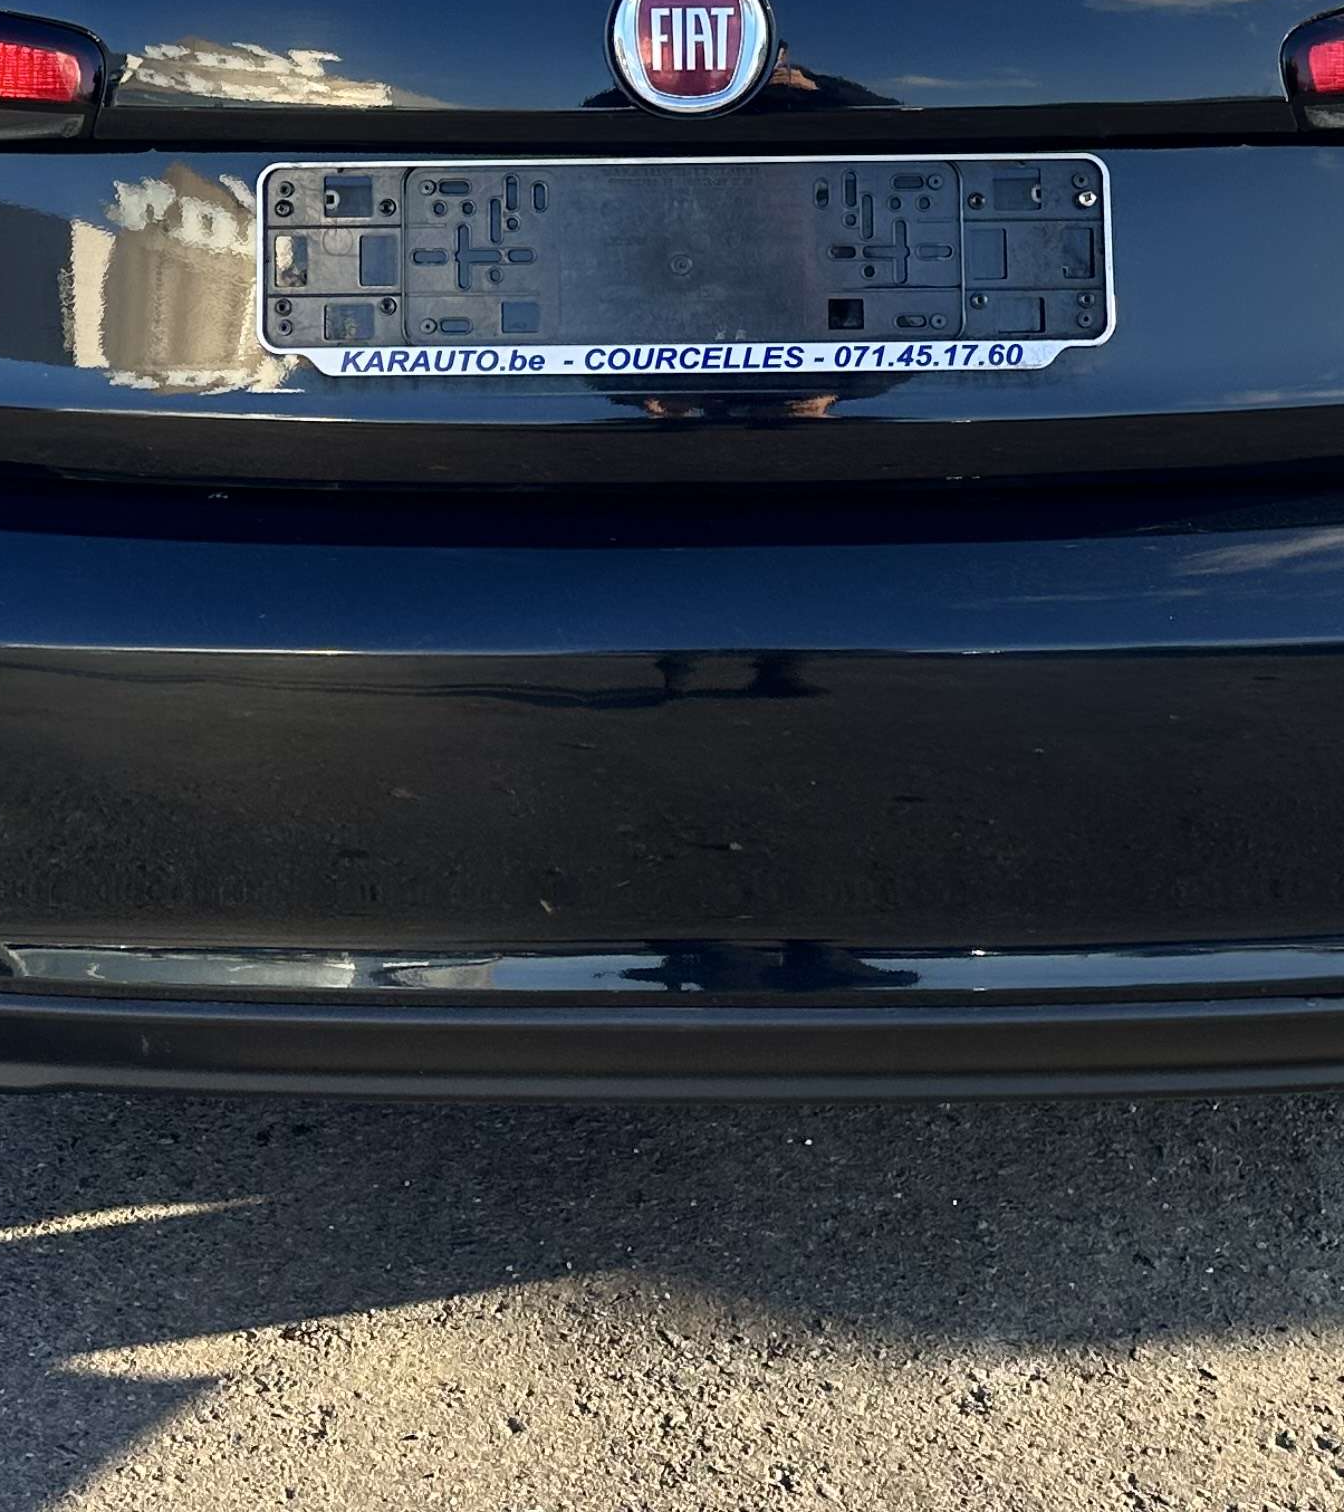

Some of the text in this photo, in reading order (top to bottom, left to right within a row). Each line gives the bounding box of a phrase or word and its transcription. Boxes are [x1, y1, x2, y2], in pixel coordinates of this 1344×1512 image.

[650, 7, 735, 72] FIAT
[340, 349, 545, 373] KARAUTO.be
[583, 345, 805, 371] COURCELLES
[833, 343, 1024, 369] 071.45.17.60
